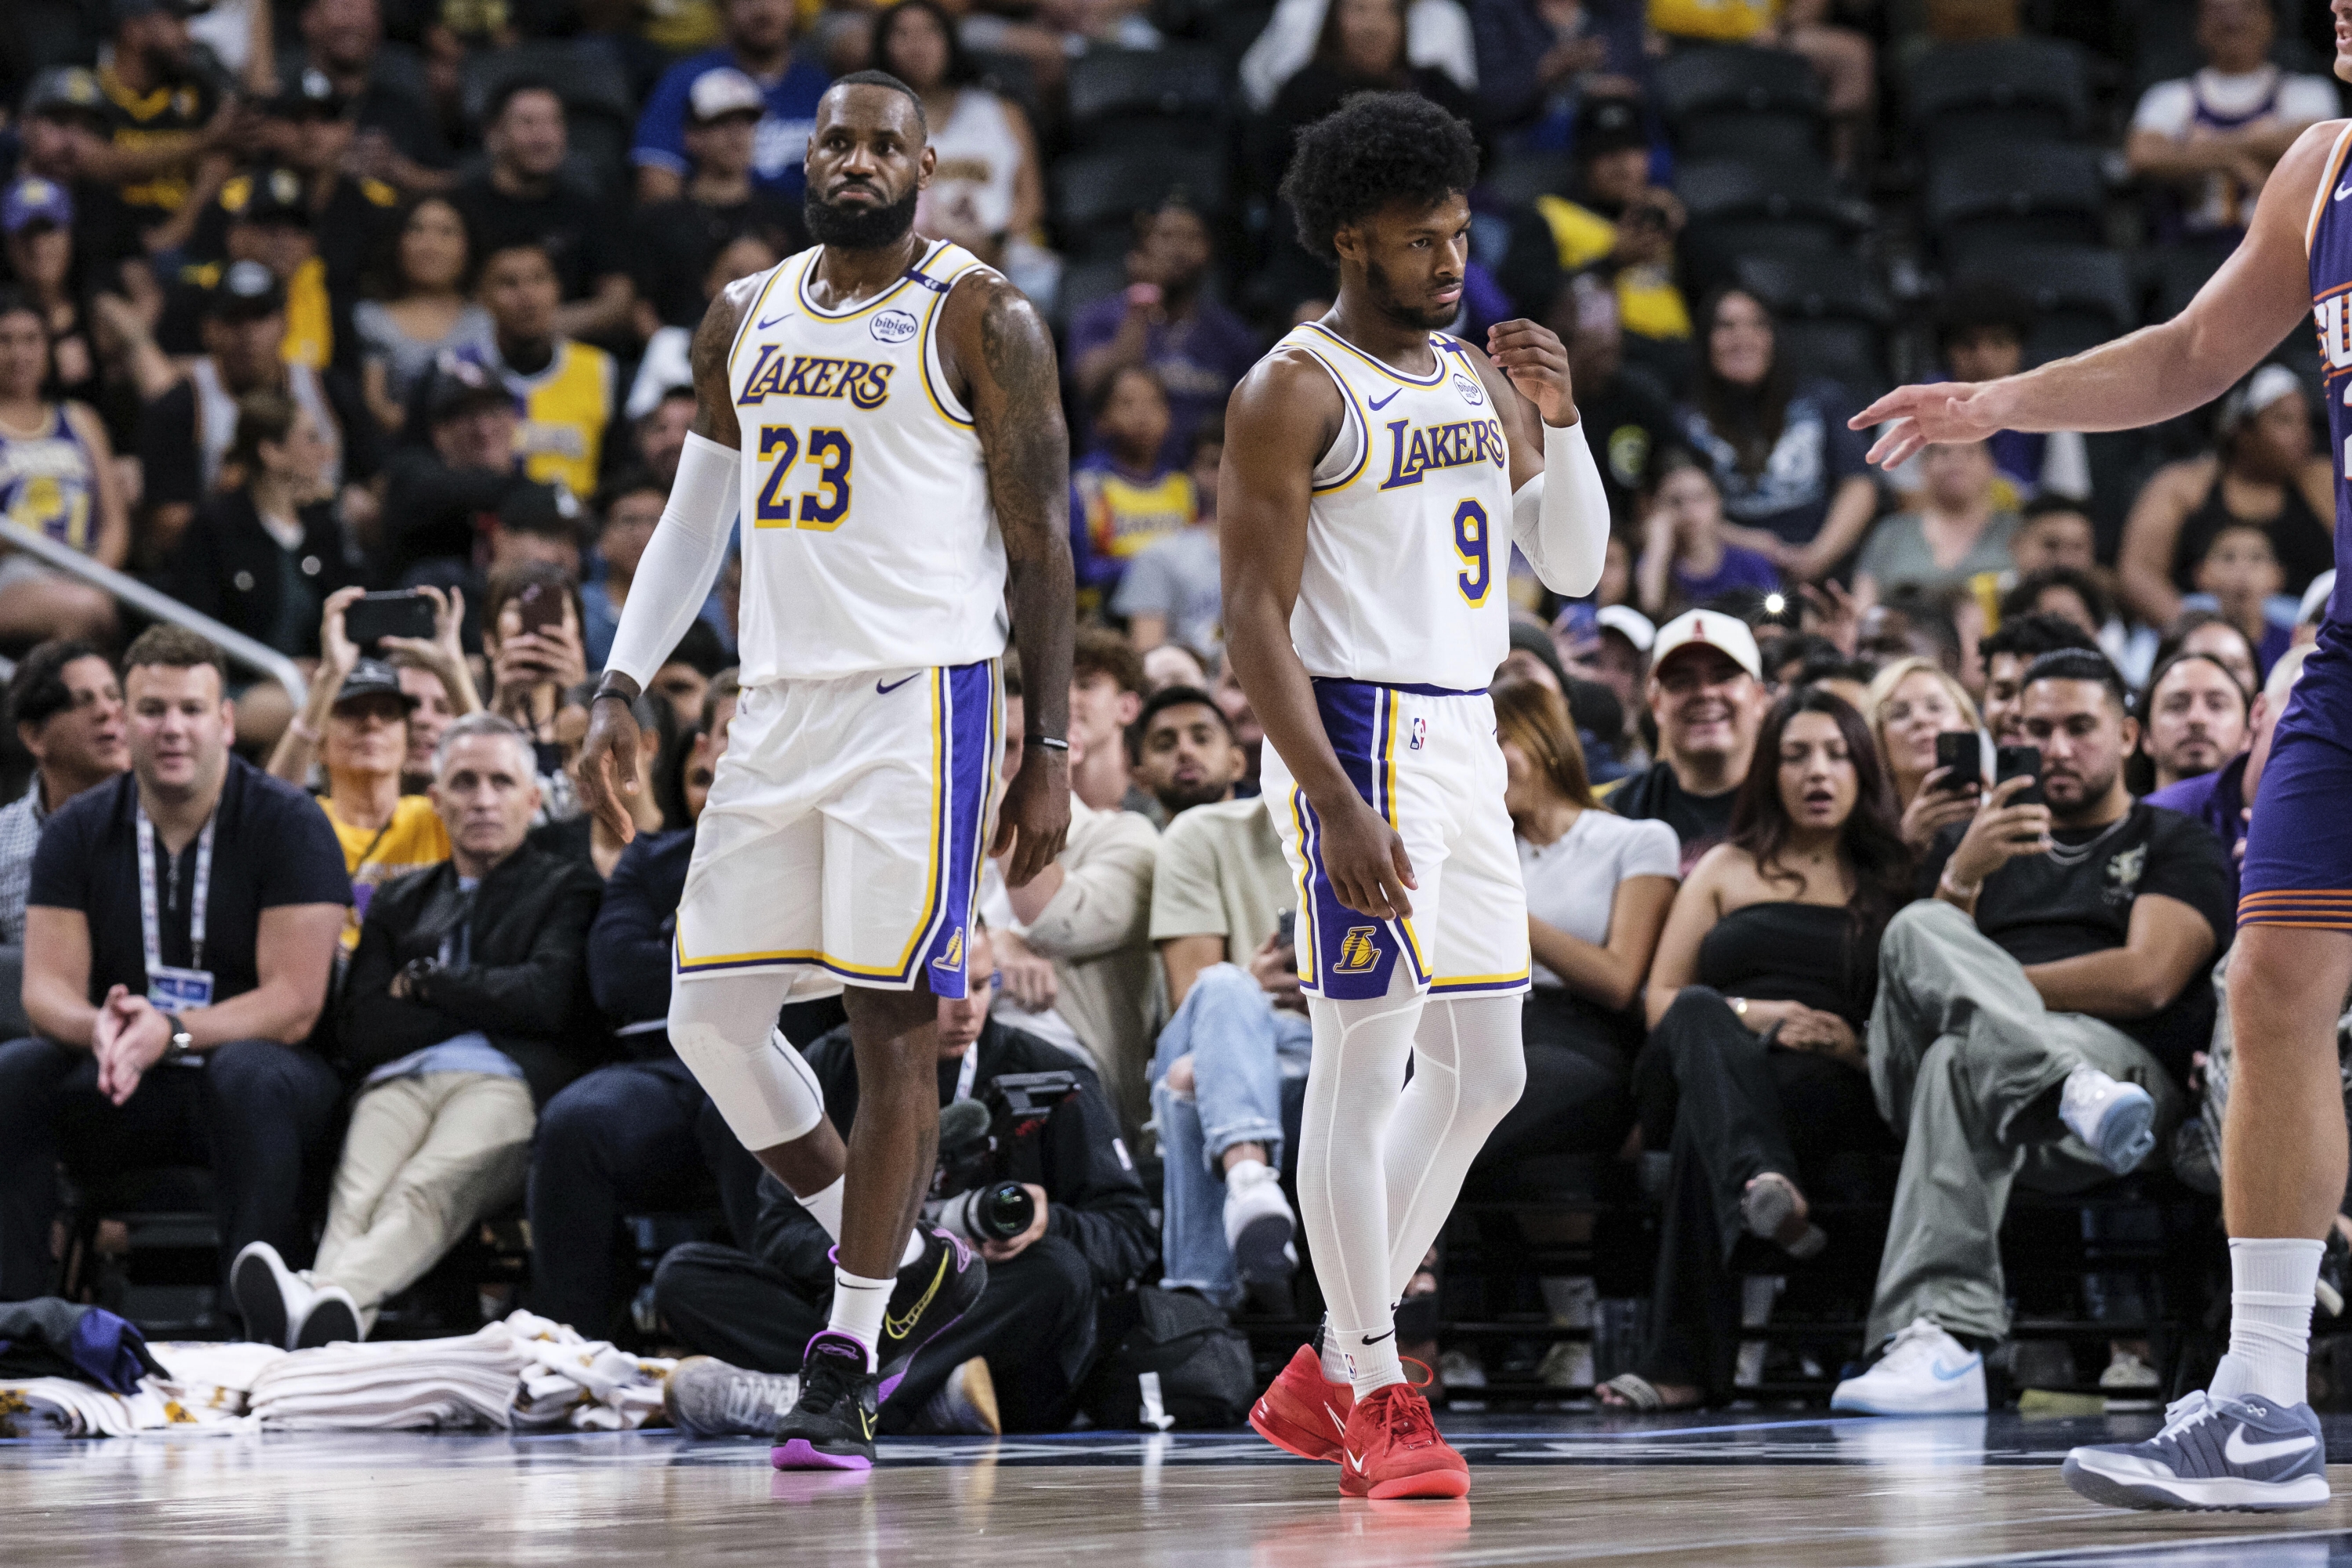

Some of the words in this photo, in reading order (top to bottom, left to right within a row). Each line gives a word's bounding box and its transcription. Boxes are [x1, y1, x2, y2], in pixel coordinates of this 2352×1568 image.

[875, 317, 915, 335] bibigo
[737, 343, 896, 412] LAKERS
[754, 424, 854, 532] 23
[1377, 418, 1505, 493] LAKERS
[1451, 496, 1492, 609] 9
